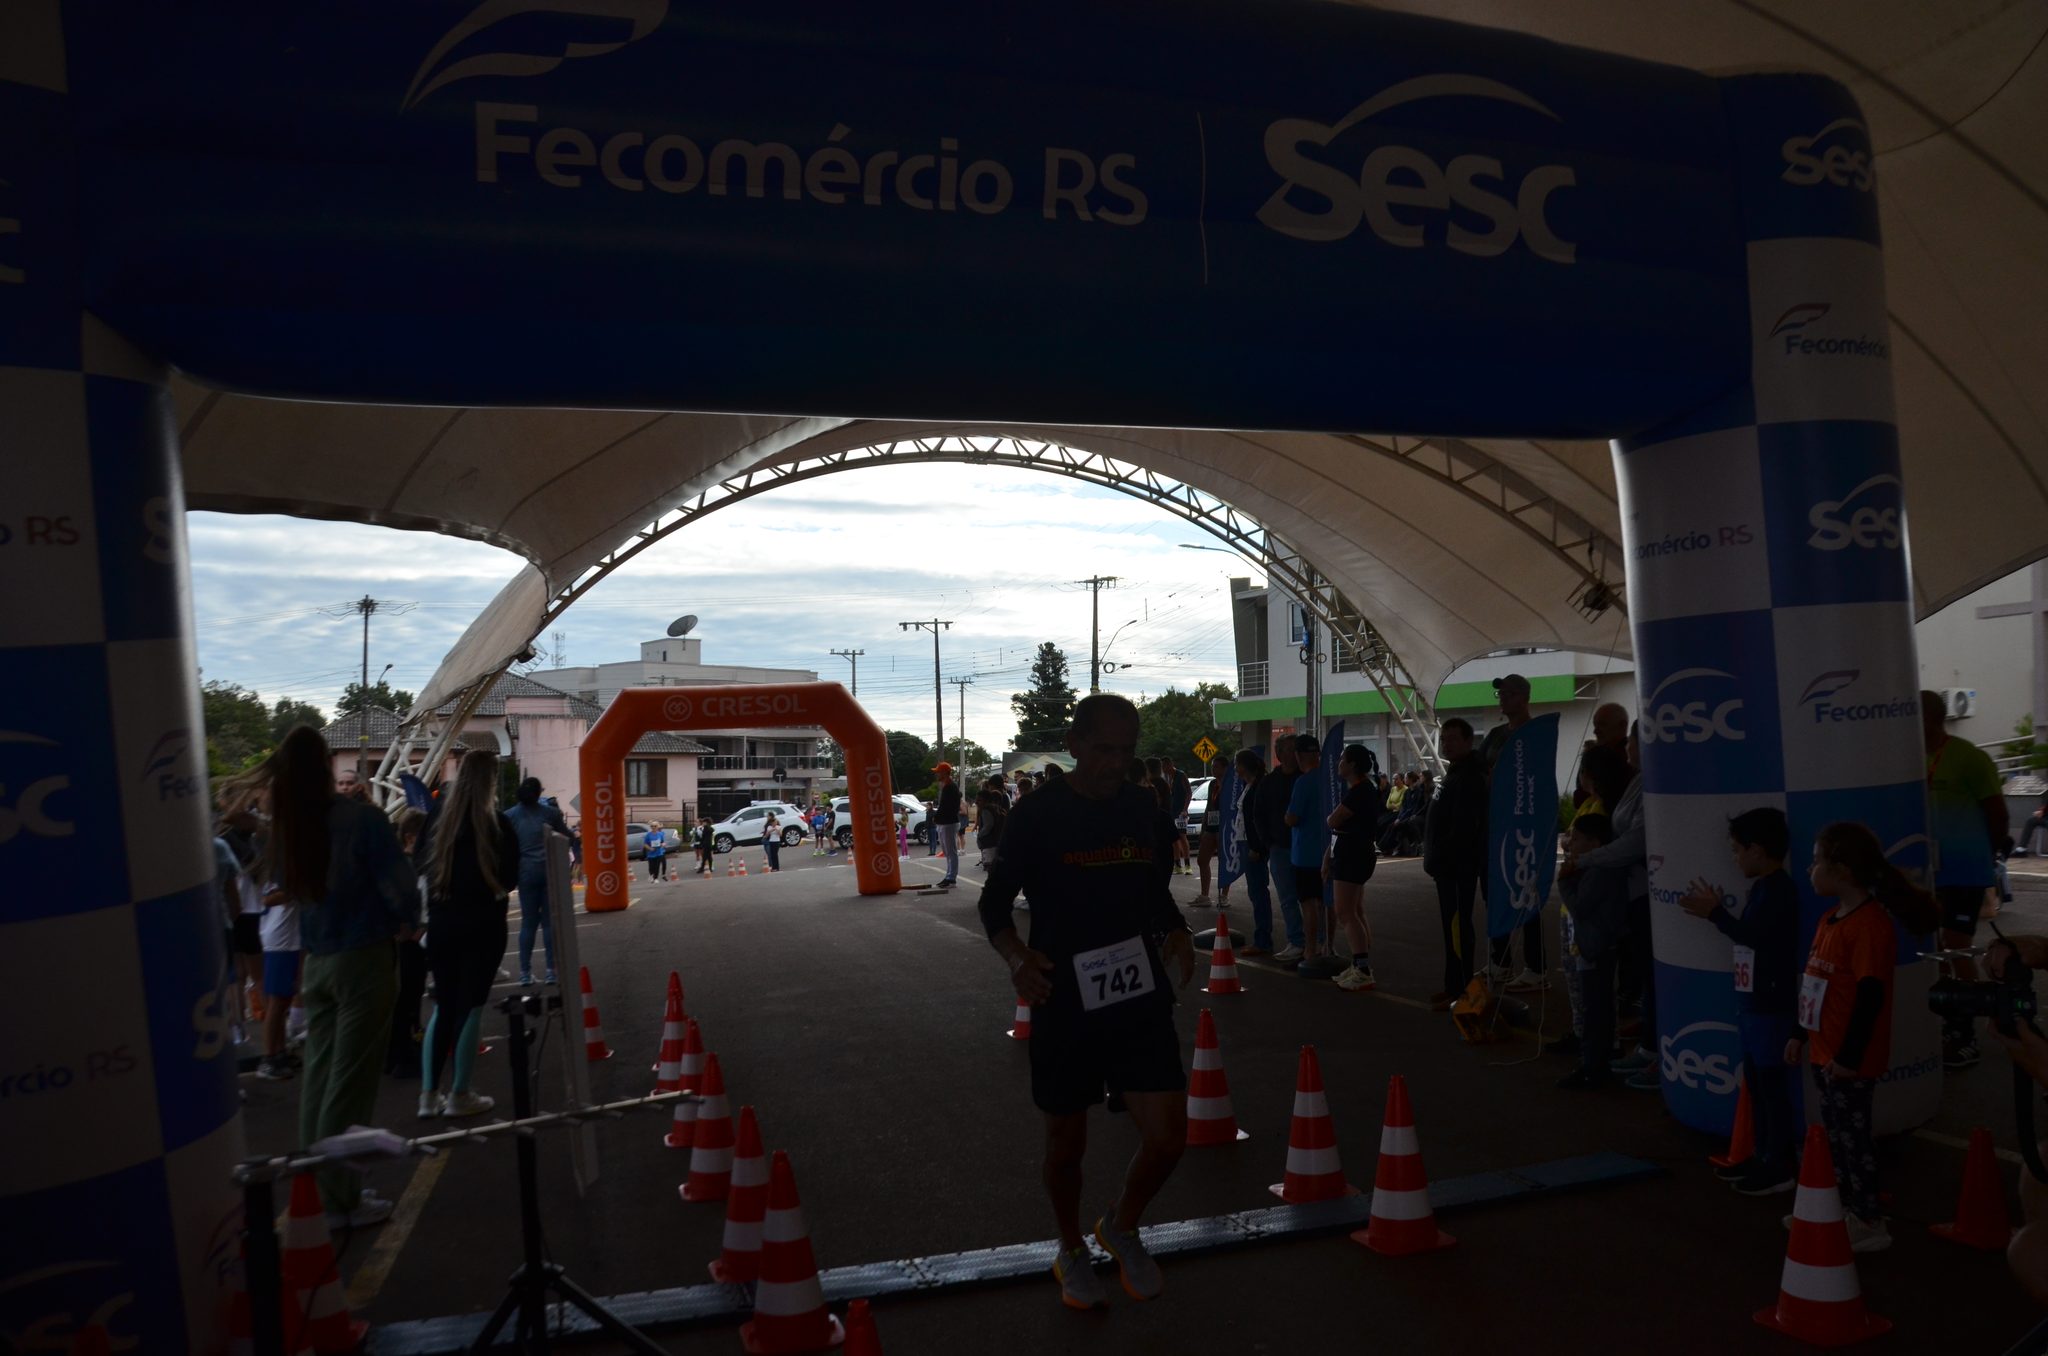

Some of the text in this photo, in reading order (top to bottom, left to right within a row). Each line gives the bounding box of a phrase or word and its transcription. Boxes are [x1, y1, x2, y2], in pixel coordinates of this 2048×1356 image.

[475, 100, 1149, 226] Fecomércio RS
[1255, 117, 1577, 265] Sesc
[1779, 135, 1873, 192] Ses
[1718, 524, 1753, 547] RS
[1806, 500, 1900, 551] Ses
[702, 693, 808, 718] CRESOL
[865, 758, 889, 846] CRESOL
[1512, 738, 1524, 816] Fecomércio
[595, 773, 614, 865] CRESOL
[1091, 964, 1142, 1001] 742
[87, 1044, 137, 1081] RS
